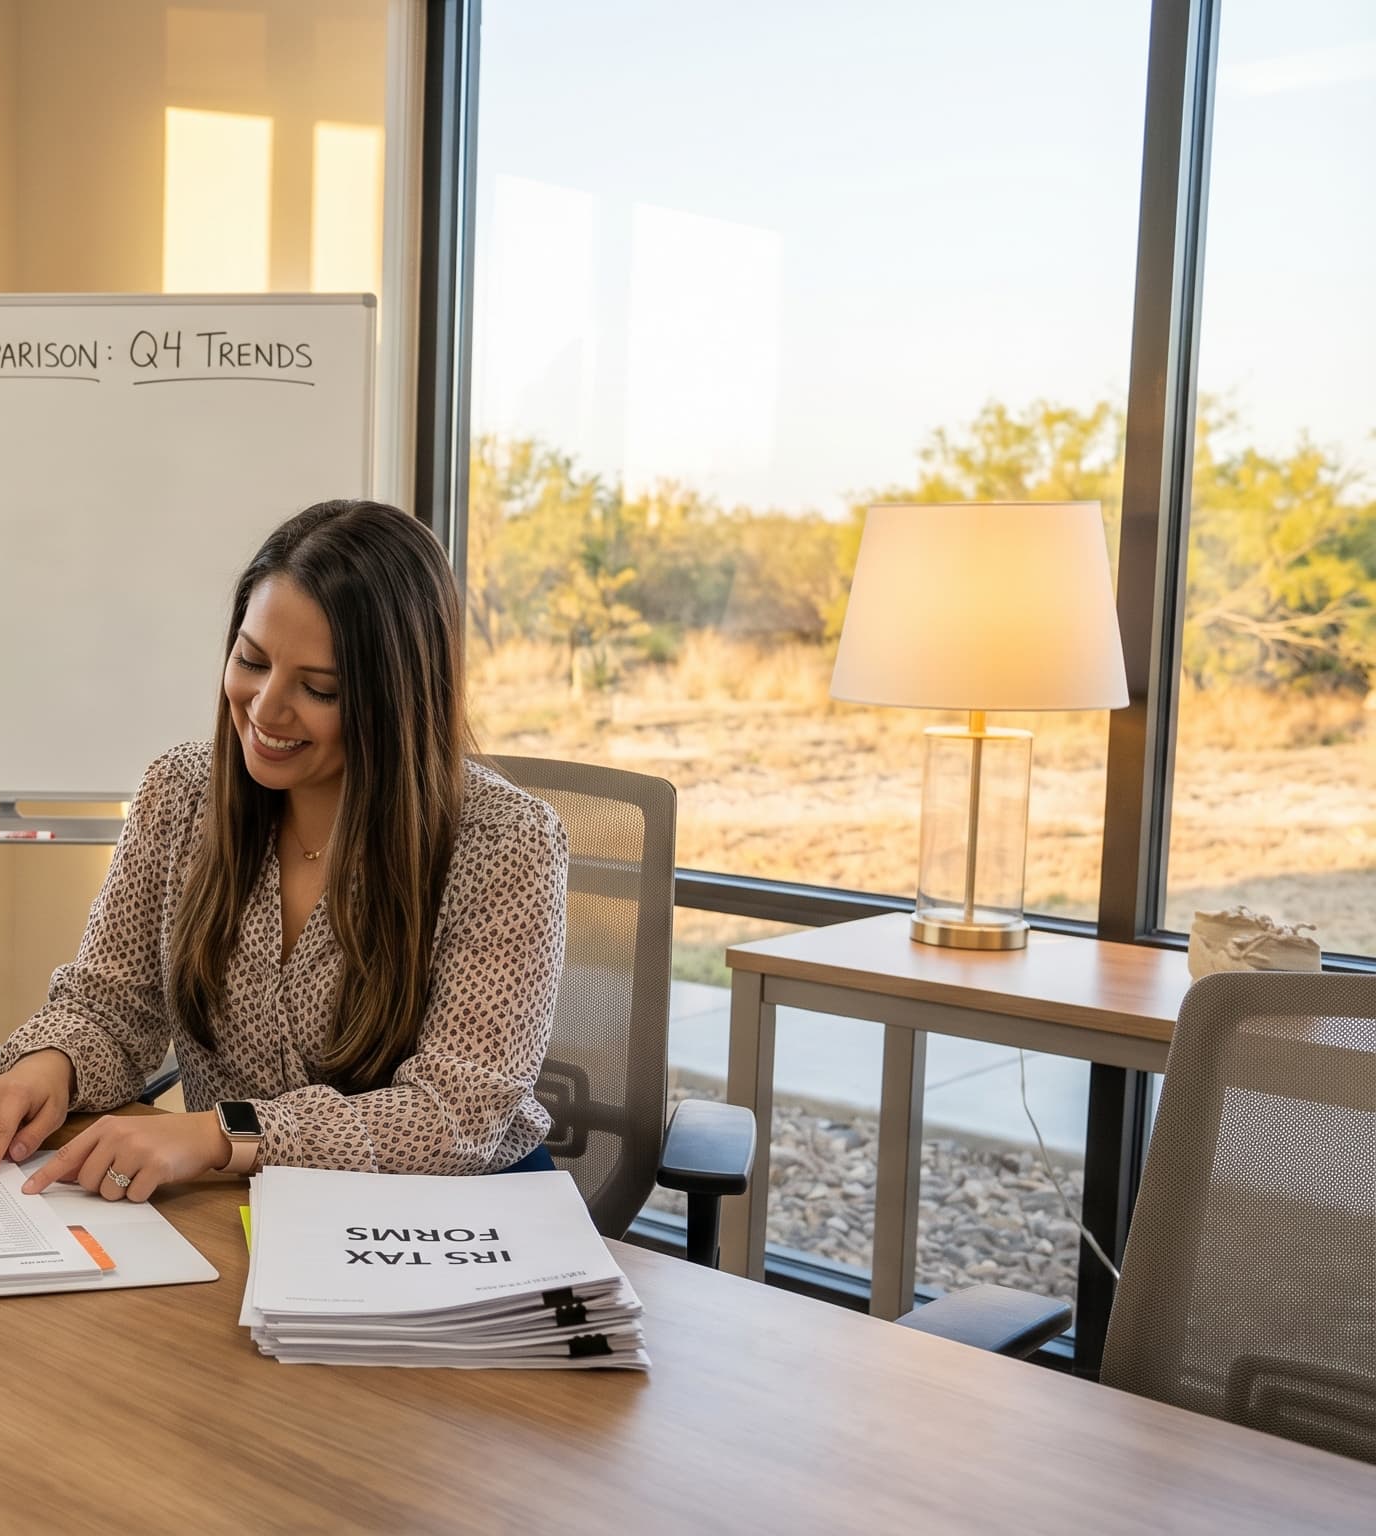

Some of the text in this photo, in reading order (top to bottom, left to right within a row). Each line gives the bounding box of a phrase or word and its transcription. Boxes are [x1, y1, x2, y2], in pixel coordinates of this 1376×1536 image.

[129, 330, 183, 370] Q4
[196, 332, 314, 370] TRENDS
[346, 1226, 500, 1243] FORMS
[345, 1249, 513, 1266] IRS TAX
